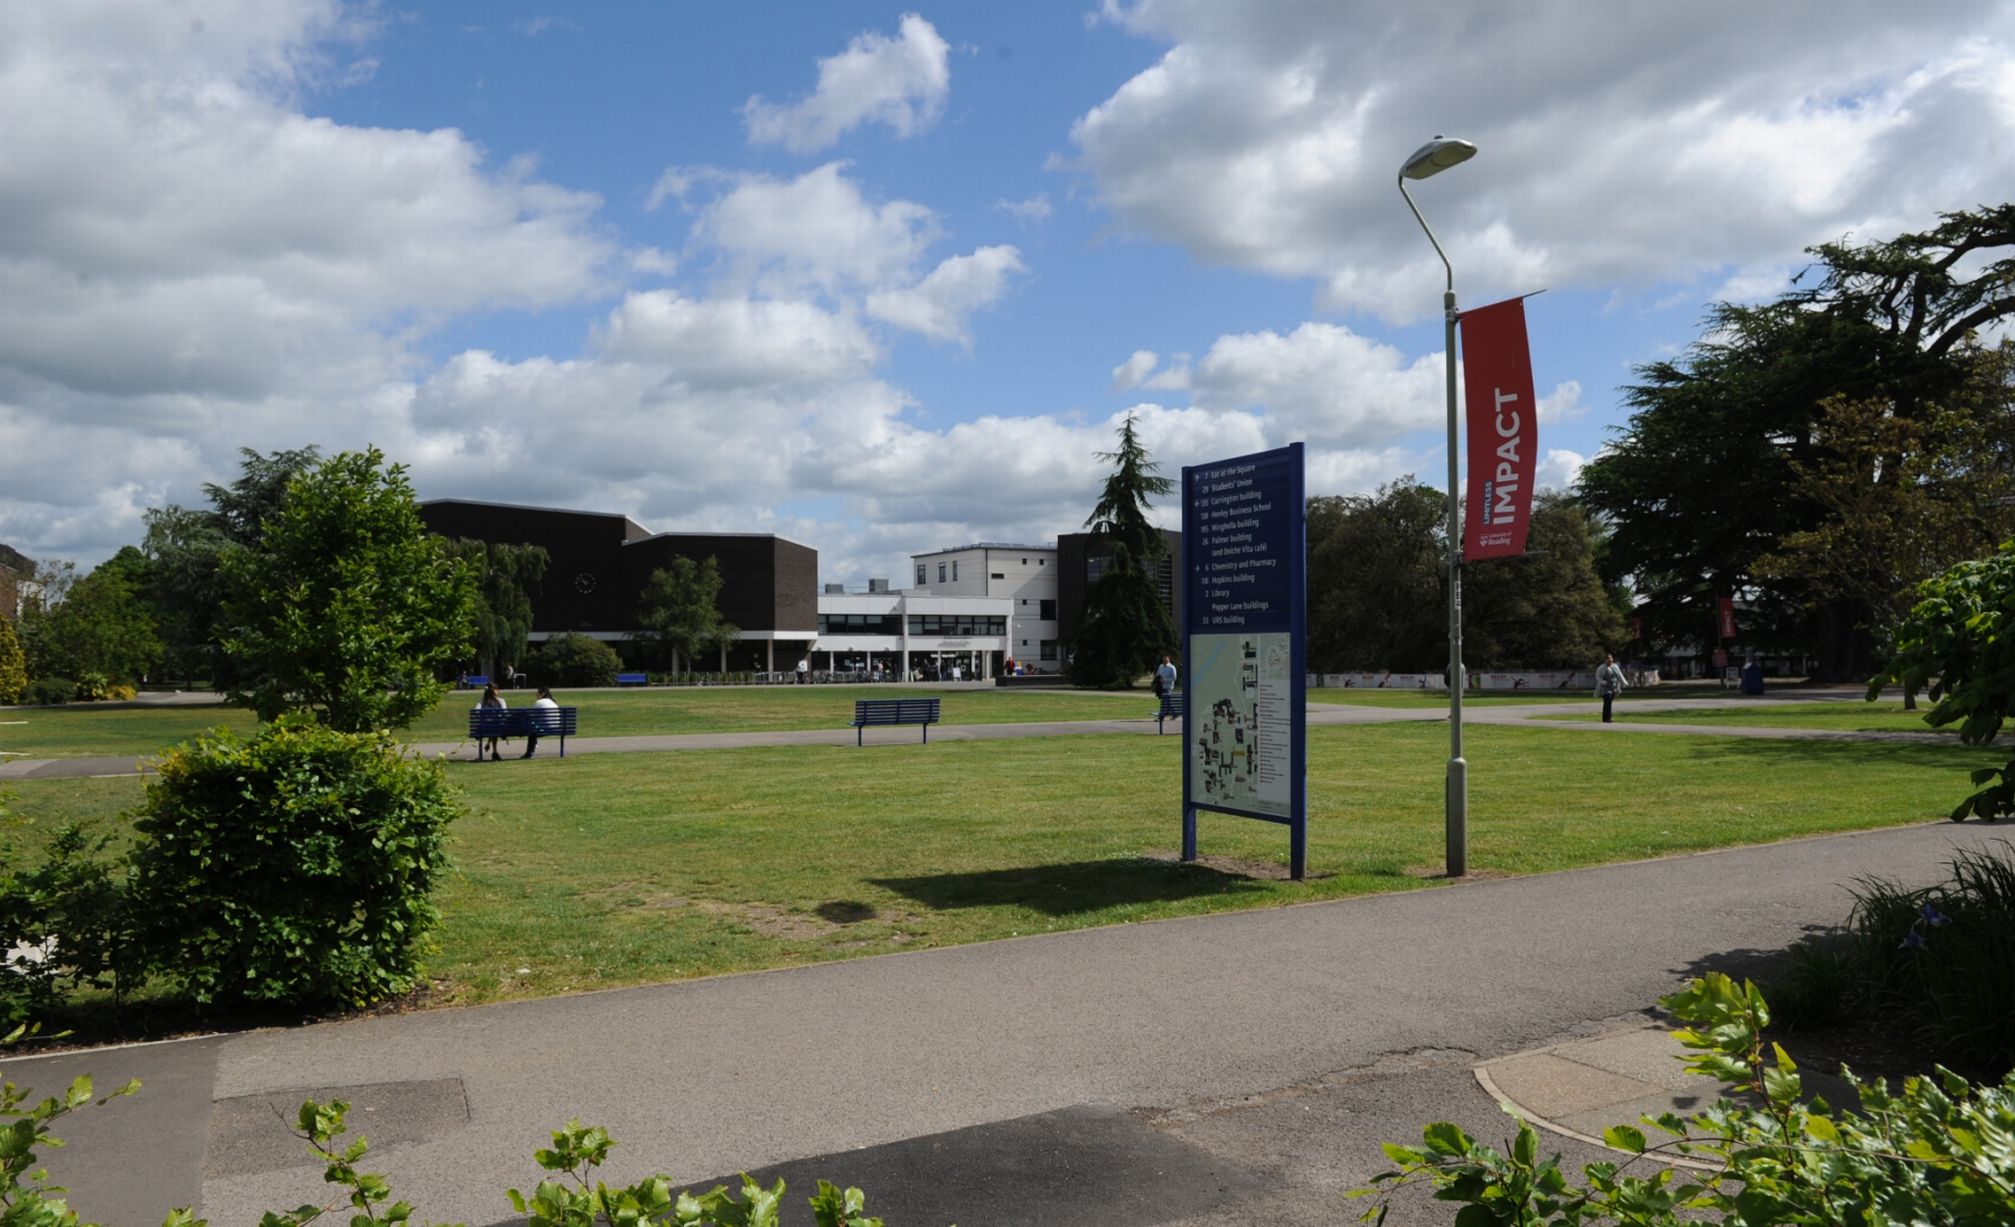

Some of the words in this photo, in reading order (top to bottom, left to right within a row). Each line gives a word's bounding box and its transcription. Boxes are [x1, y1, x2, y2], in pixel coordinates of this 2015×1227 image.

[1492, 387, 1521, 525] IMPACT
[1211, 470, 1220, 479] Eat
[1220, 469, 1226, 477] at
[1227, 467, 1236, 475] the
[1236, 465, 1256, 476] Square
[1236, 478, 1253, 487] Union
[1211, 494, 1239, 505] Carrington
[1239, 491, 1262, 501] building
[1211, 509, 1229, 518] Henley
[1229, 505, 1252, 516] Business
[1253, 502, 1271, 512] School
[1237, 518, 1260, 528] building
[1211, 536, 1229, 544] Palmer
[1230, 533, 1252, 542] building
[1241, 545, 1253, 553] Vita
[1211, 561, 1238, 571] Chemistry
[1238, 560, 1249, 568] and
[1249, 559, 1277, 568] Pharmacy
[1211, 576, 1232, 585] Hopkins
[1232, 573, 1256, 583] building
[1211, 589, 1230, 598] Library
[1212, 602, 1229, 613] Pepper
[1230, 602, 1242, 611] Lane
[1243, 600, 1269, 611] buildings
[1223, 615, 1245, 626] building
